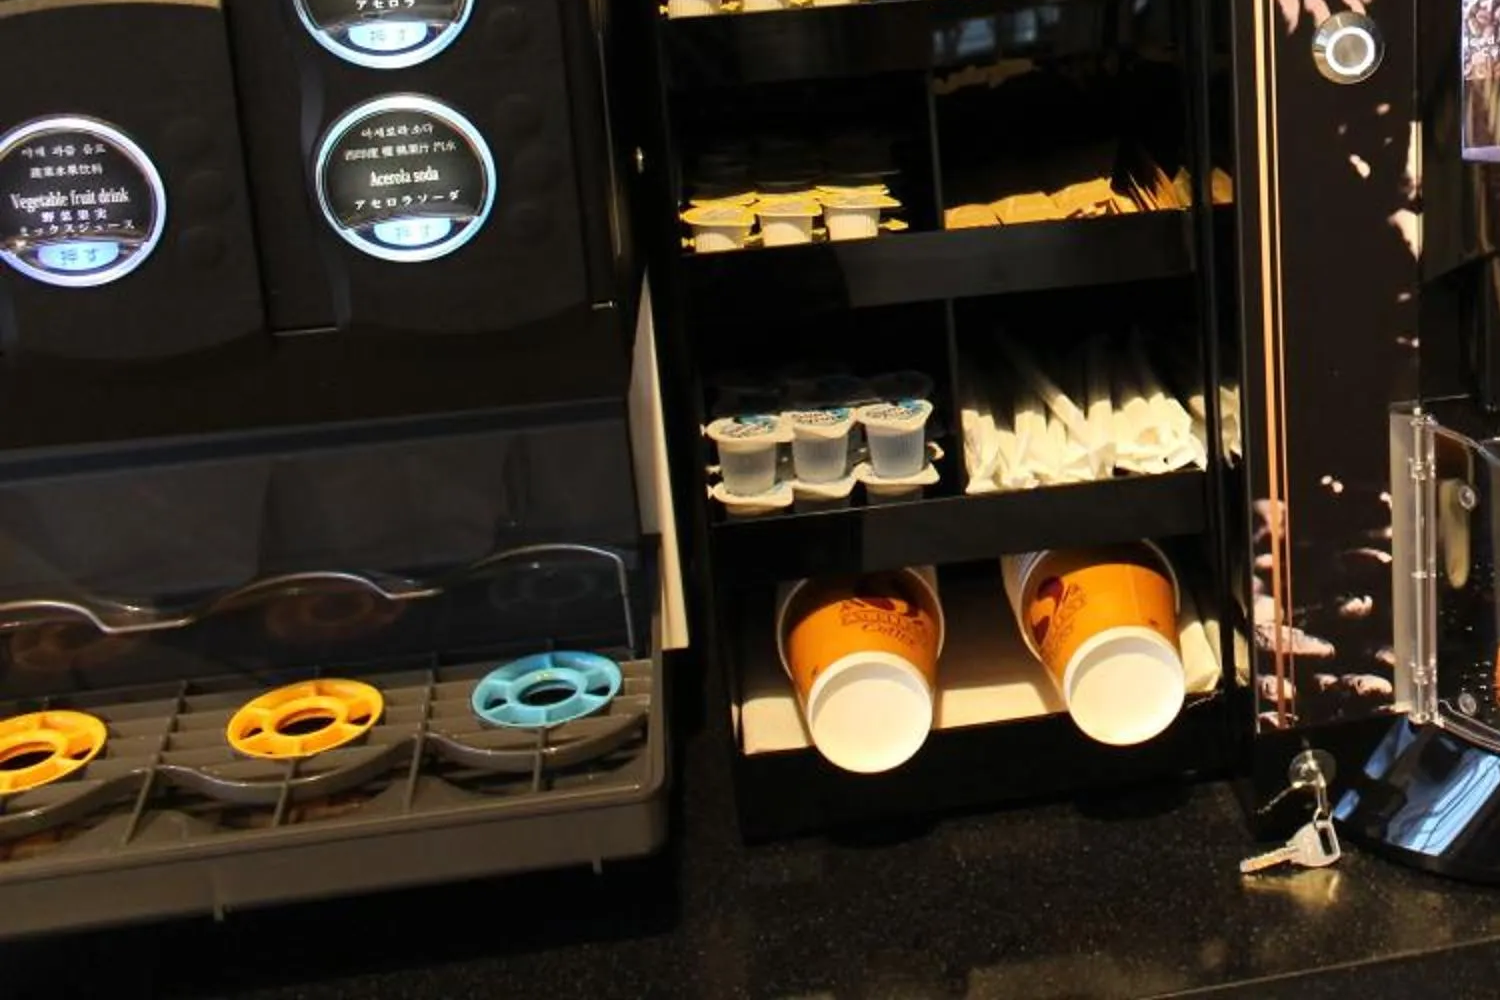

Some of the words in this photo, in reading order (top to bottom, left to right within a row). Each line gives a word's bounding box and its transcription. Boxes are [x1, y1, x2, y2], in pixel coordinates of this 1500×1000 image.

[370, 169, 412, 188] Acerola
[413, 164, 440, 183] soda
[9, 191, 69, 213] Vegetable
[69, 188, 96, 206] fruit
[98, 186, 130, 205] drink
[354, 189, 461, 211] アセロラソーダ
